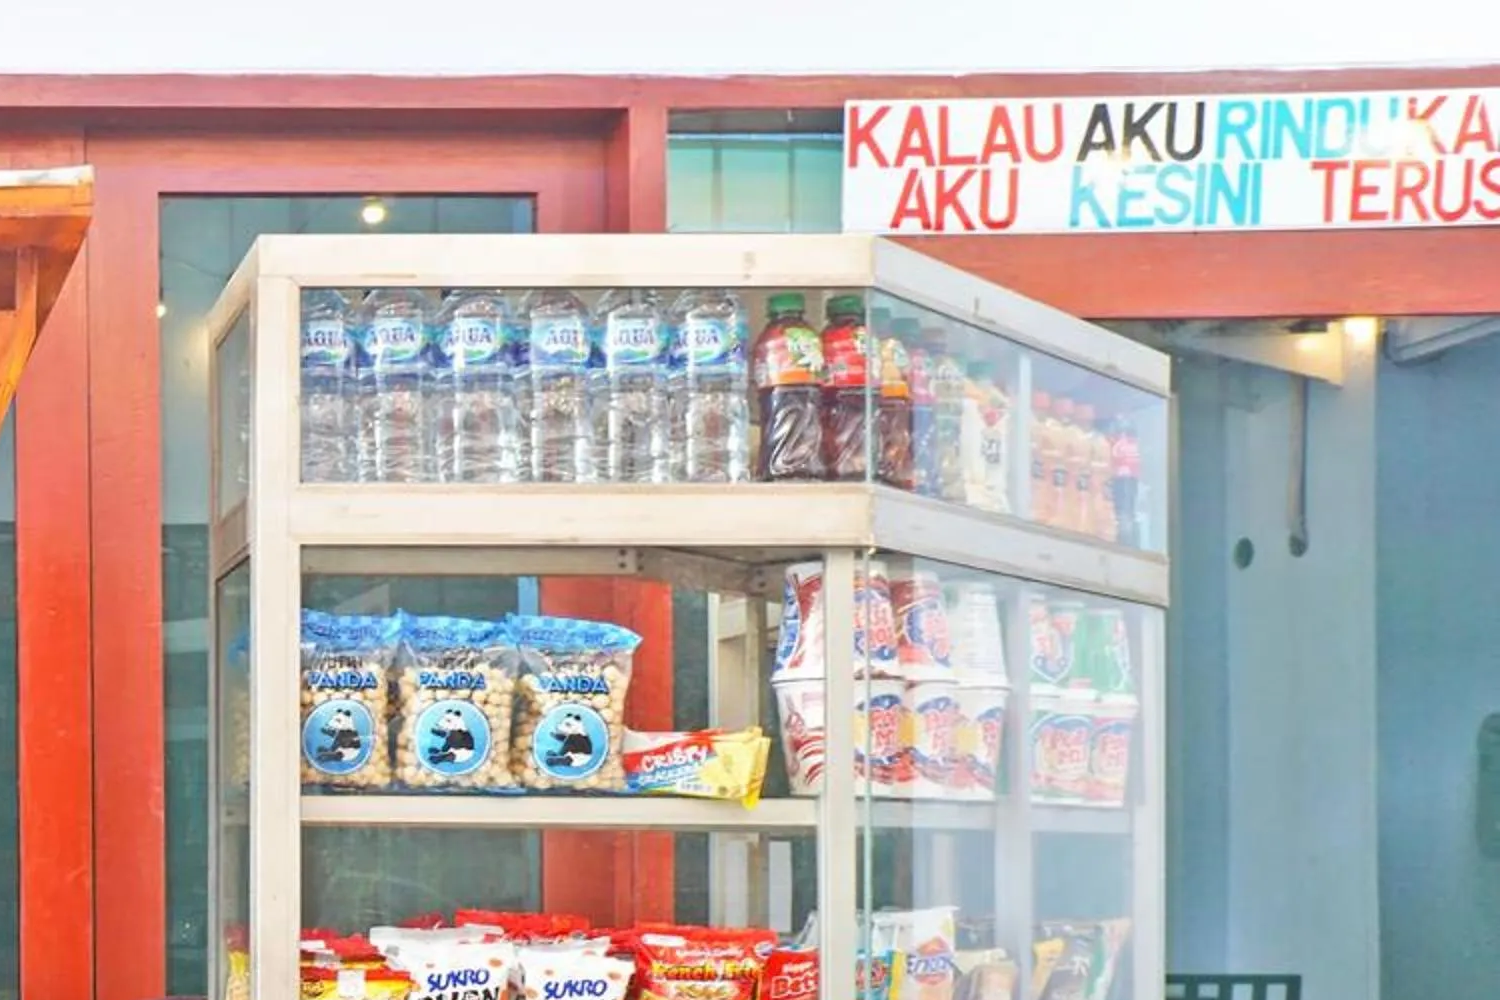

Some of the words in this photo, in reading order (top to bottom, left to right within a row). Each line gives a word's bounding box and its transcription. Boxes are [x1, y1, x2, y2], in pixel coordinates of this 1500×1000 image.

[848, 103, 1063, 167] KALAU
[1076, 101, 1205, 162] AKU
[1408, 95, 1500, 155] KA
[890, 168, 1019, 231] AKU
[1069, 162, 1262, 227] KESINI
[1311, 158, 1500, 222] TERUS
[307, 671, 378, 690] PANDA
[419, 671, 486, 690] PANDA
[427, 968, 490, 992] SUKRO
[544, 979, 608, 1000] SUKRO
